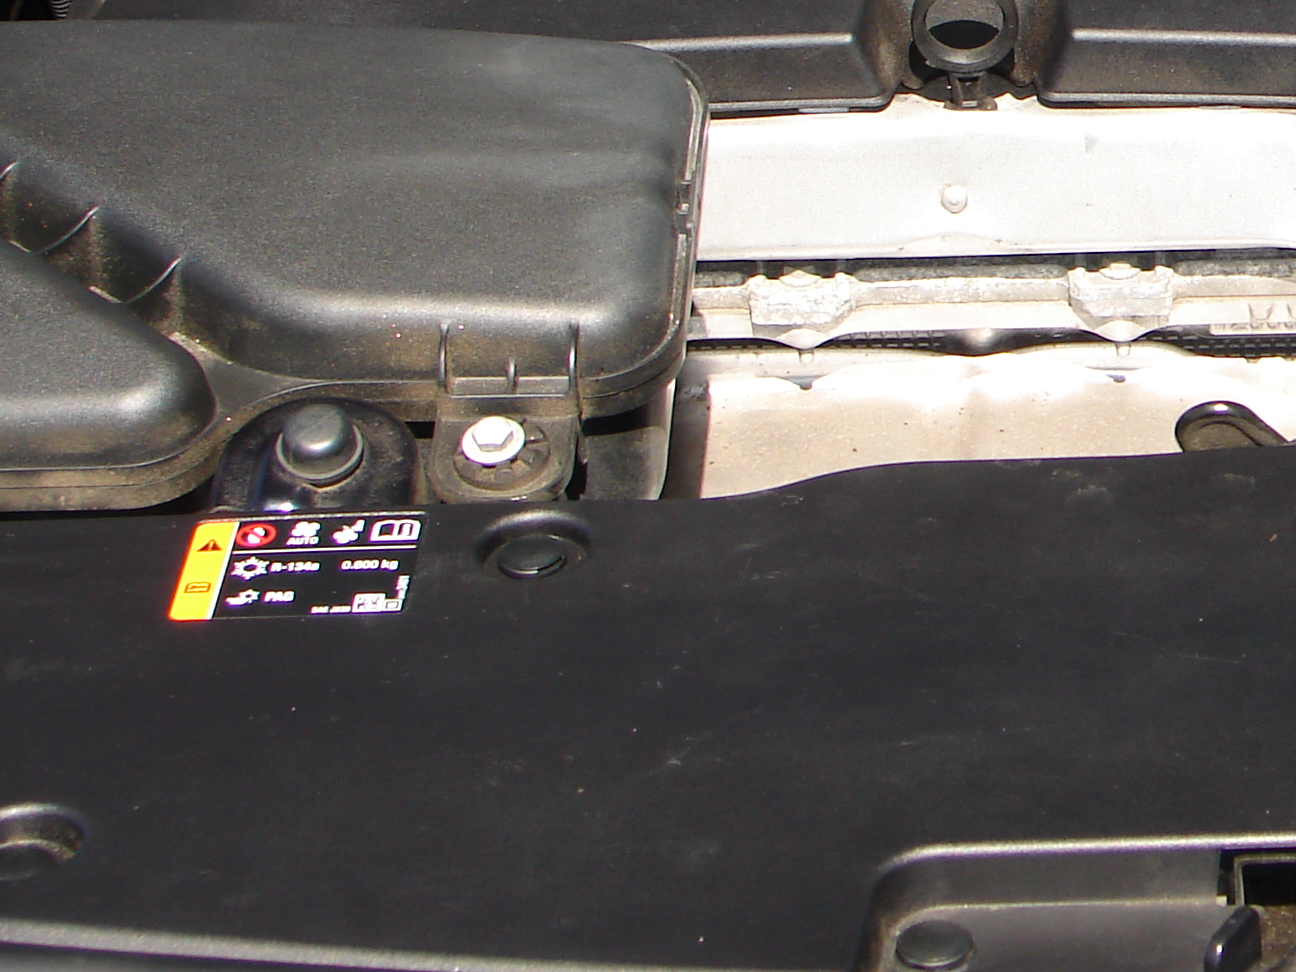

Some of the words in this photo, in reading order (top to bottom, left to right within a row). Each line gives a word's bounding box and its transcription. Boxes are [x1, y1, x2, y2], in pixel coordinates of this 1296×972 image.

[287, 536, 319, 546] AUTO
[270, 561, 320, 572] R-134a
[381, 558, 399, 571] kg
[264, 590, 295, 602] PAG
